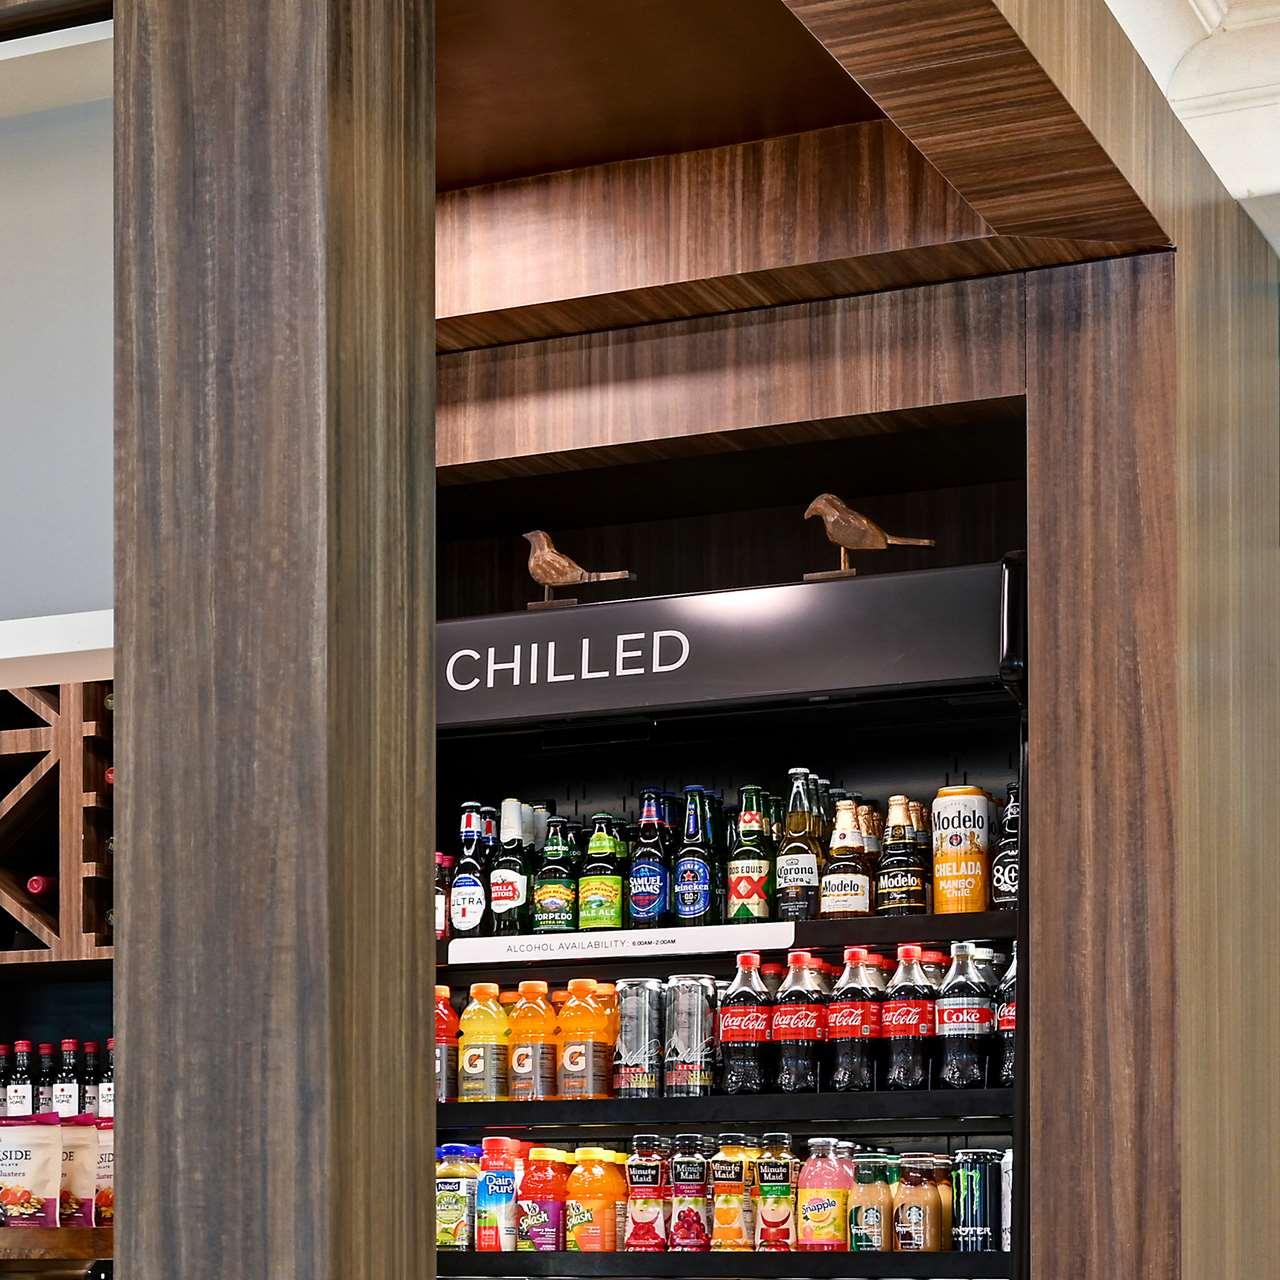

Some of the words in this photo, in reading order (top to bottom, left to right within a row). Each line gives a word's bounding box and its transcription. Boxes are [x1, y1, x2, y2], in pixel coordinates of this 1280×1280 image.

[445, 628, 690, 692] CHILLED
[932, 810, 985, 831] Modelo
[741, 865, 763, 874] EQUIS
[777, 865, 814, 878] Corona
[935, 861, 982, 877] CHELADA
[629, 876, 664, 887] SAMUEL
[879, 873, 917, 888] Modelo
[630, 885, 660, 896] ADAMS
[675, 882, 710, 893] Heineken
[823, 880, 860, 893] Modelo
[535, 912, 572, 922] TORPEDO
[507, 942, 555, 953] ALCOHOL
[943, 1009, 980, 1024] Coke
[463, 1048, 484, 1074] G
[511, 1047, 533, 1074] G
[562, 1045, 586, 1072] G
[629, 1167, 657, 1175] Minute
[676, 1164, 703, 1173] Minute
[712, 1163, 740, 1172] Minute
[759, 1165, 787, 1173] Minute
[680, 1172, 700, 1180] Maid
[714, 1171, 736, 1179] Maid
[763, 1173, 784, 1181] Maid
[488, 1184, 514, 1195] Pure
[801, 1198, 837, 1215] Snapple
[520, 1213, 549, 1230] Splash
[567, 1212, 593, 1229] Splash
